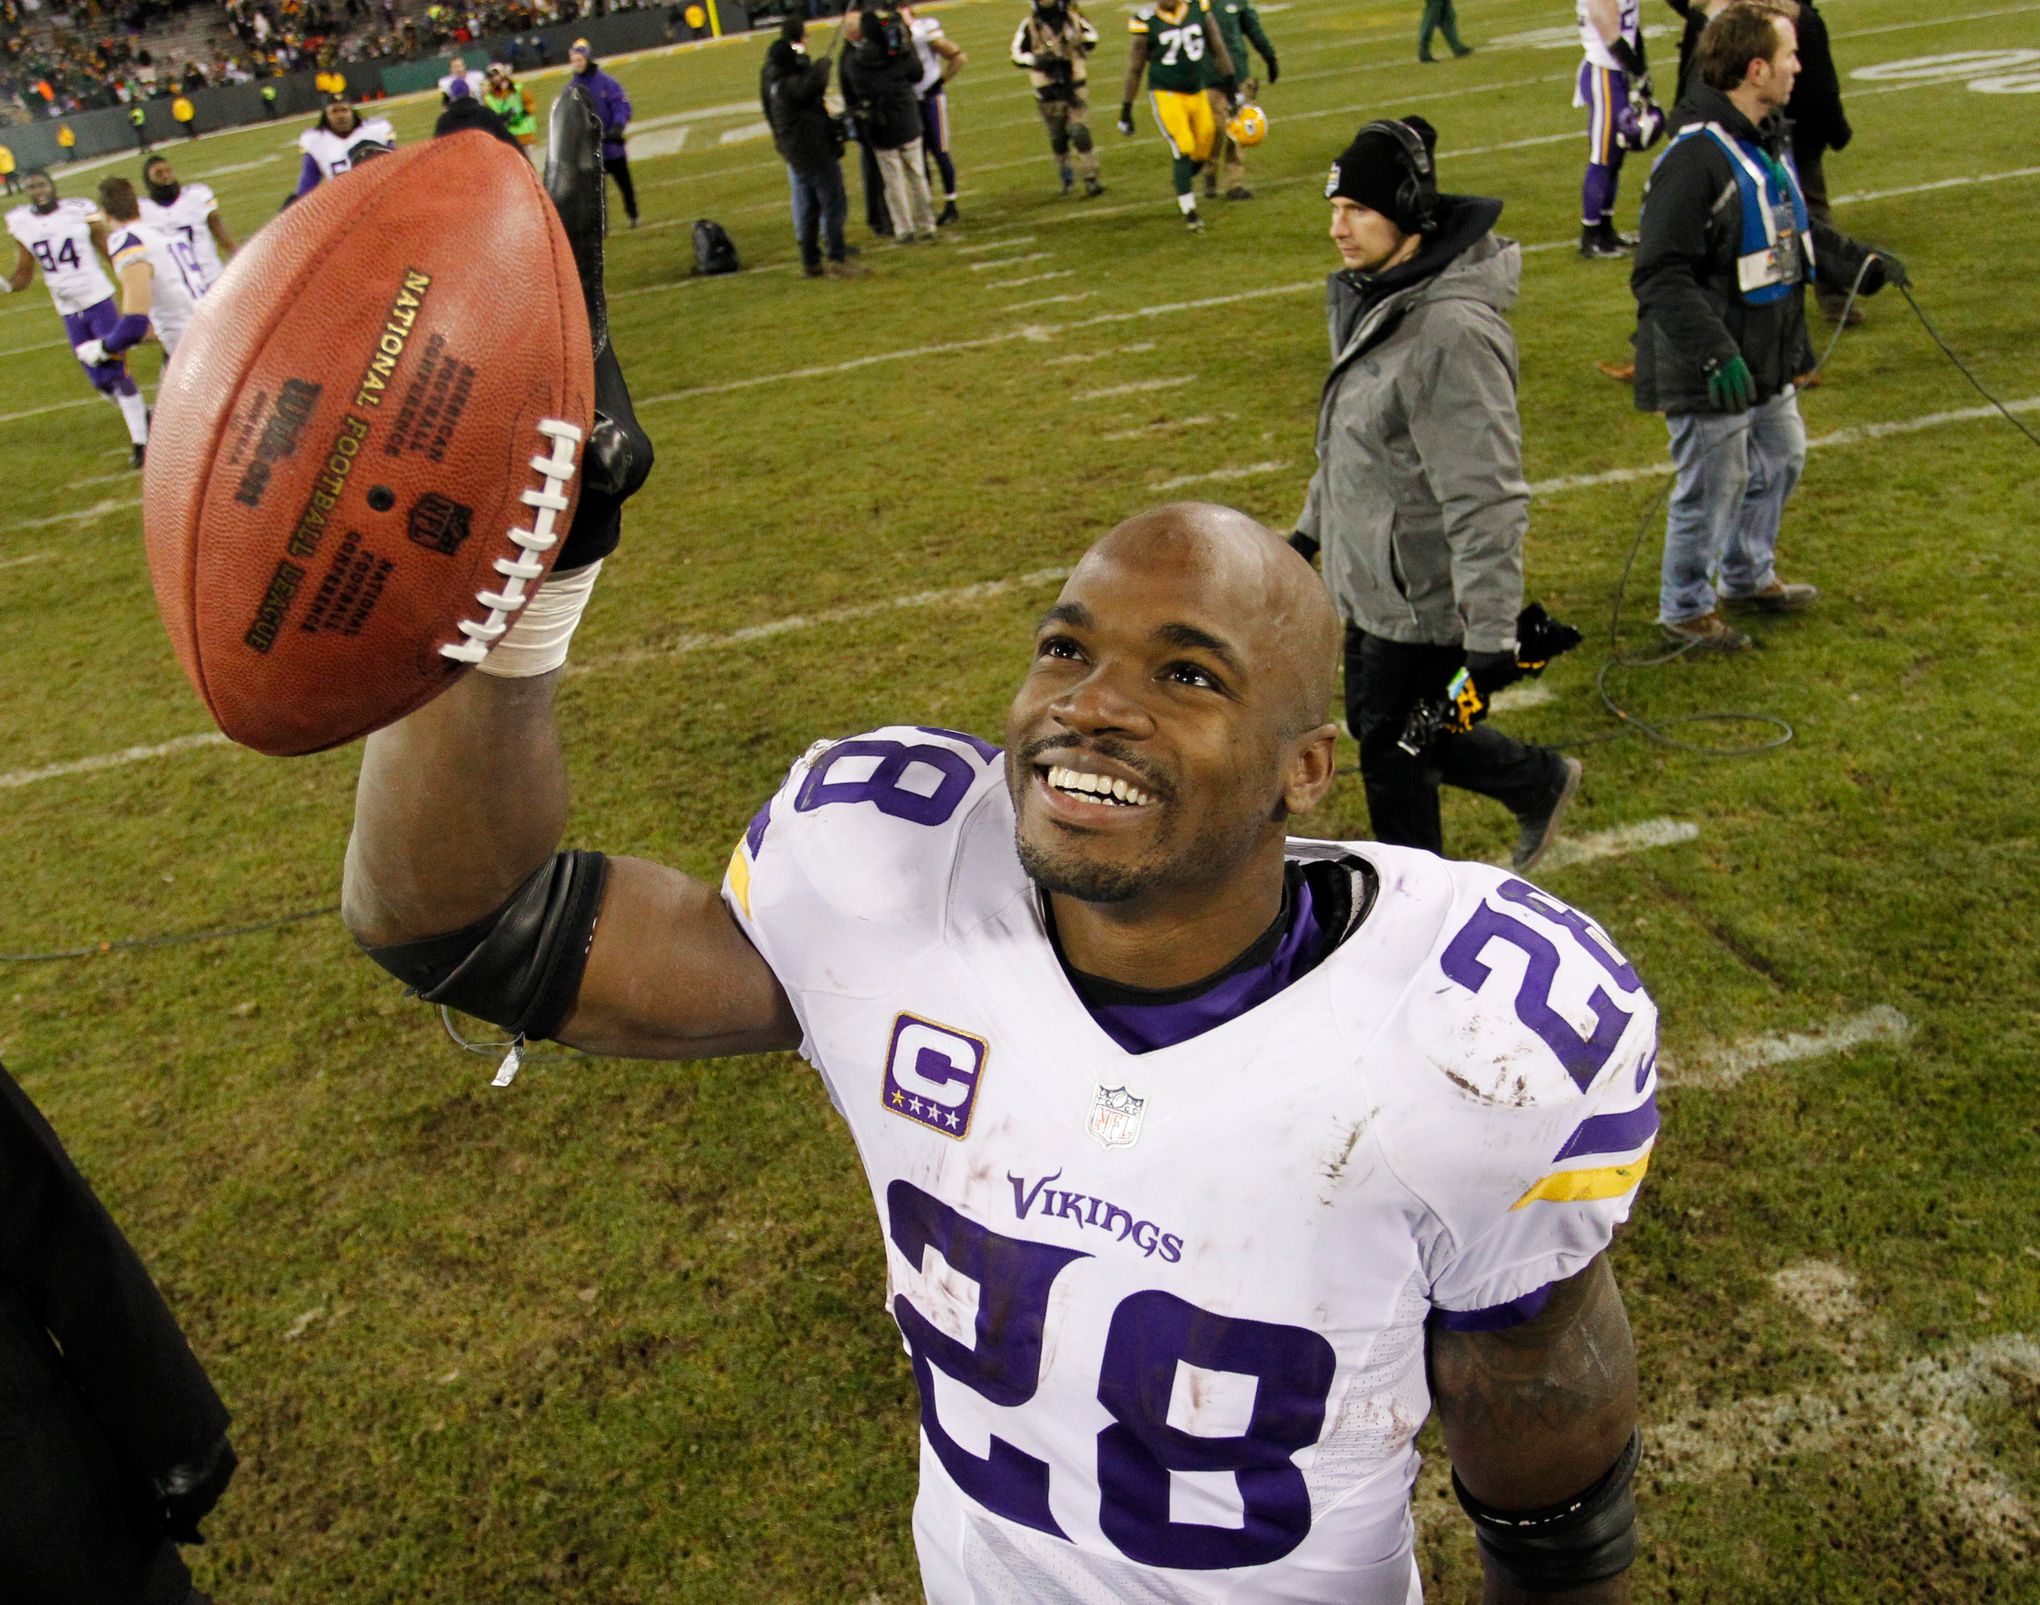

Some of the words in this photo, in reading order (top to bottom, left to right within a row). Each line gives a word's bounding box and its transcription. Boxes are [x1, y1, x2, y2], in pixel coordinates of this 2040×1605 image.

[1158, 23, 1205, 66] 76
[33, 237, 80, 273] 84
[356, 267, 431, 408] NATIONAL
[384, 334, 446, 457] CONFERENCE
[410, 356, 459, 450] FOOTBALL
[424, 365, 475, 463] AMERICAN
[289, 413, 369, 556] FOOTBALL
[245, 559, 305, 653] LEAGUE
[301, 531, 361, 633] CONFERENCE
[324, 551, 374, 630] FOOTBALL
[345, 559, 395, 636] NATIONAL
[892, 1023, 976, 1108] C
[1093, 1107, 1133, 1140] NFL
[887, 1179, 1337, 1571] 28
